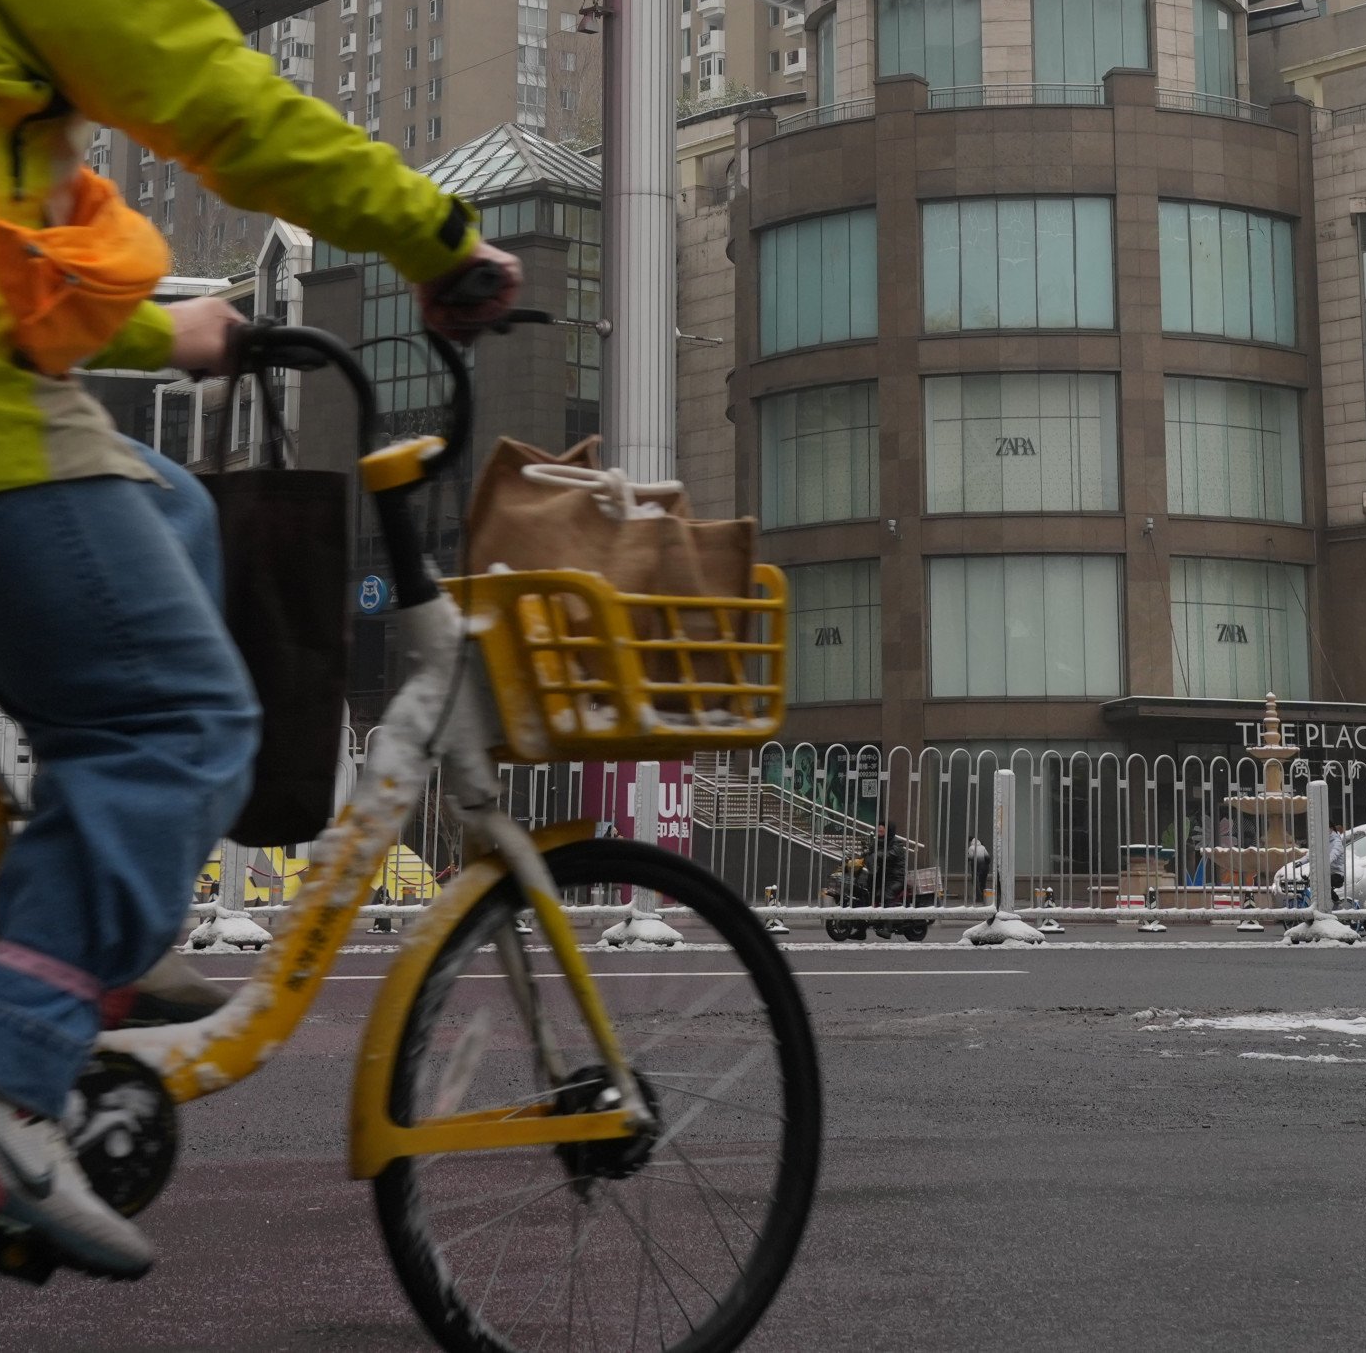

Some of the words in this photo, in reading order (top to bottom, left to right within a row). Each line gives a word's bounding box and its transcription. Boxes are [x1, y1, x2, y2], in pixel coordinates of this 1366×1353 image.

[995, 436, 1036, 457] ZARA
[814, 626, 843, 647] ZARA
[1215, 623, 1249, 643] ZARA
[627, 782, 693, 819] UJI
[657, 820, 690, 839] 印良品
